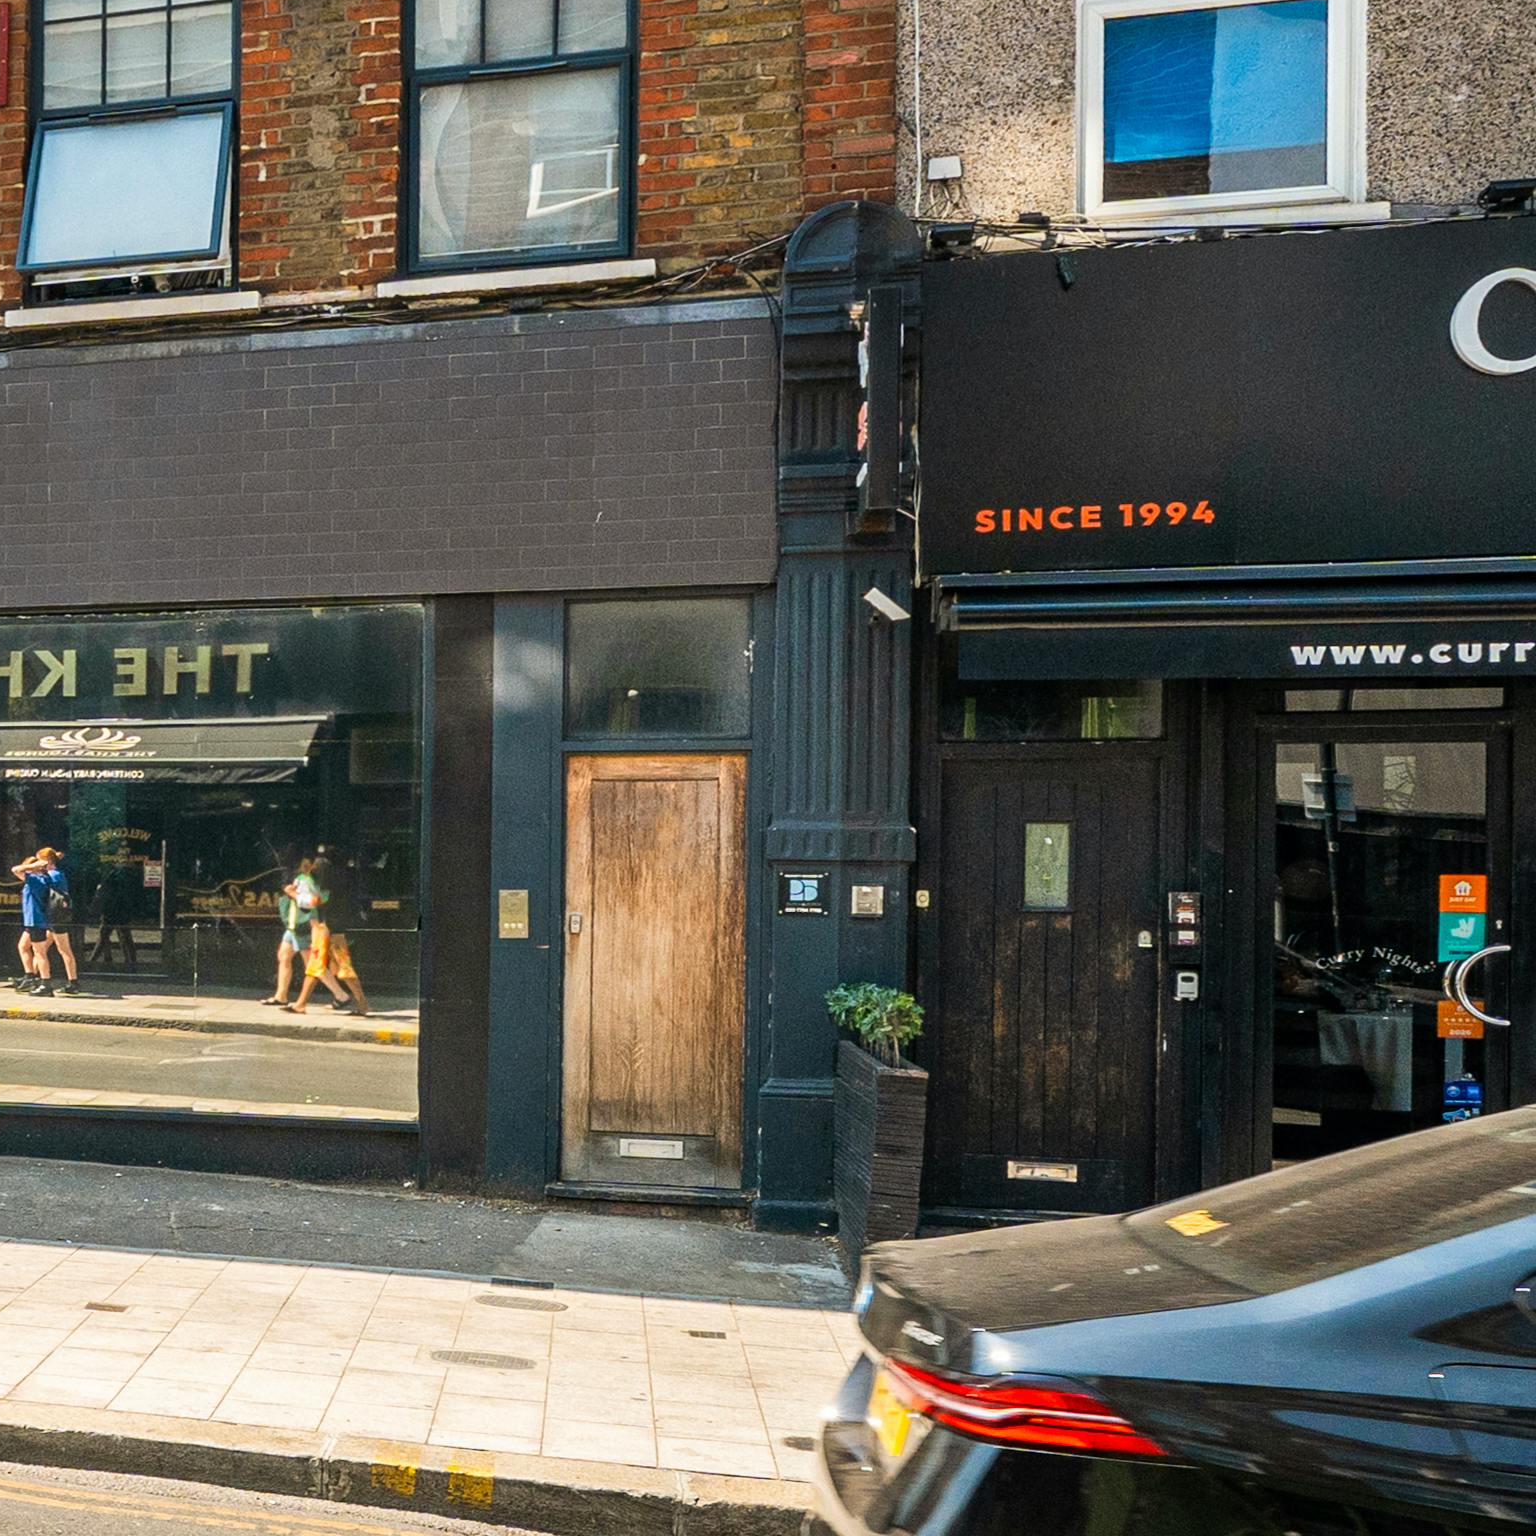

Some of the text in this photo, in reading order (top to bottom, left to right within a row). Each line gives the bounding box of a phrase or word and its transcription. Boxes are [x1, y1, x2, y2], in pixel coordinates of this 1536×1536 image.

[975, 500, 1216, 533] SINCE 1994
[1290, 642, 1536, 665] www.curr
[1372, 946, 1424, 974] Nights
